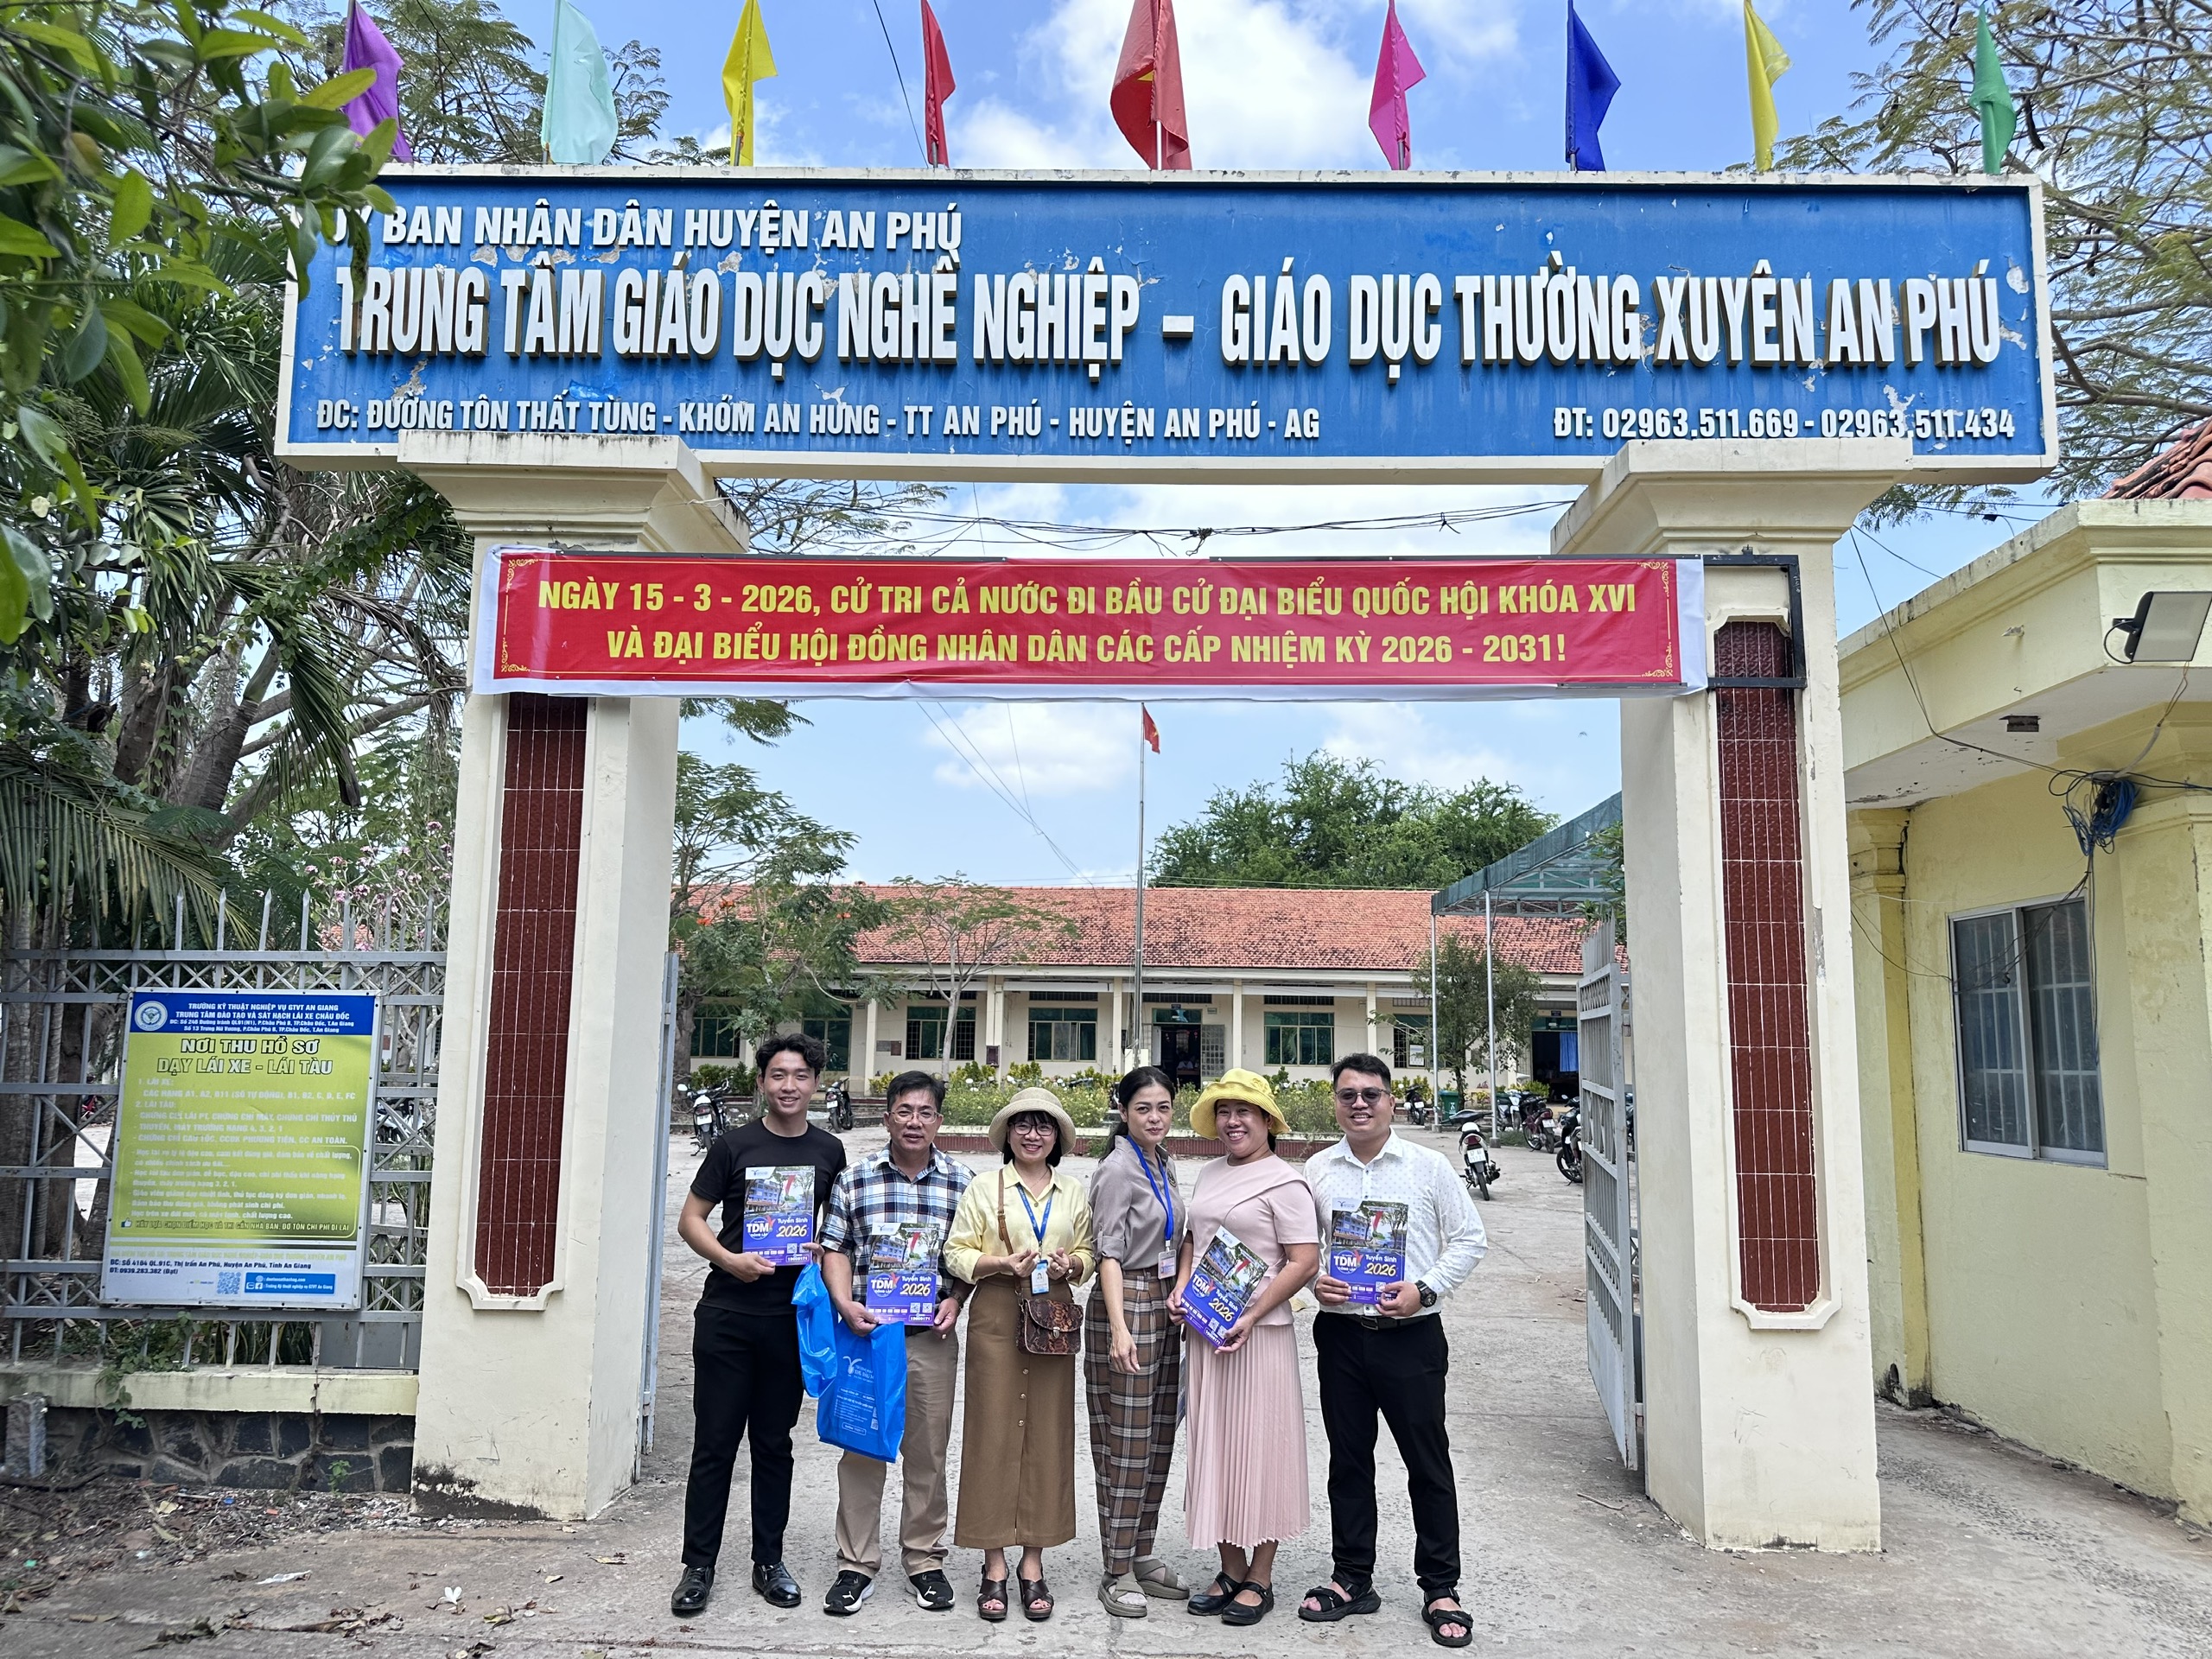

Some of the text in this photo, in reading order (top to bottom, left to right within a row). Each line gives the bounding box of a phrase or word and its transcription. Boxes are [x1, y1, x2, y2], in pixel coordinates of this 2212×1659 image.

[383, 206, 462, 245] BAN
[474, 198, 580, 246] NHÂN
[601, 199, 672, 247] DÂN
[685, 200, 809, 256] HUYỆN
[821, 210, 875, 249] AN
[887, 203, 962, 251] PHÚ
[336, 266, 486, 353] TRUNG
[501, 251, 602, 354] TÂM
[613, 251, 722, 356] GIÁO
[734, 269, 824, 380] DỤC
[838, 249, 962, 361] NGHỀ
[973, 257, 1141, 382] NGHIỆP
[1222, 257, 1332, 365] GIÁO
[1349, 272, 1442, 383] DỤC
[1454, 251, 1640, 365] THƯỜNG
[1656, 259, 1813, 365] XUYÊN
[1827, 278, 1894, 365] AN
[1904, 258, 2001, 365] PHÚ
[316, 399, 359, 429] ĐC:
[366, 391, 453, 430] ĐƯỜNG
[460, 394, 508, 429] TÔN
[517, 389, 580, 431] THẤT
[588, 393, 657, 433] TÙNG
[679, 394, 755, 433] KHÓM
[764, 403, 801, 434] AN
[810, 401, 880, 435] HƯNG
[905, 405, 933, 435] TT
[943, 405, 980, 436] AN
[991, 399, 1041, 437] PHÚ
[1069, 401, 1154, 445] HUYỆN
[1164, 408, 1200, 439] AN
[1209, 401, 1261, 439] PHÚ
[1284, 408, 1320, 439] AG
[1554, 407, 1593, 438] ĐT:
[1602, 408, 1798, 438] 02963.511.669
[1821, 408, 2016, 439] 02963.511.434
[538, 576, 619, 609] NGÀY
[630, 584, 663, 610] 15
[694, 584, 710, 611] 3
[741, 585, 820, 615] 2026,
[831, 577, 872, 613] CỬ
[880, 587, 921, 613] TRI
[932, 577, 969, 613] CẢ
[980, 581, 1057, 613] NƯỚC
[1067, 587, 1095, 613] ĐI
[1106, 577, 1162, 614] BẦU
[1173, 578, 1213, 614] CỬ
[1219, 588, 1267, 620] ĐẠI
[1277, 576, 1342, 615] BIỂU
[1357, 577, 1429, 618] QUỐC
[1440, 581, 1488, 620] HỘI
[1499, 580, 1579, 613] KHÓA
[1588, 584, 1635, 612] XVI
[607, 626, 644, 658] VÀ
[653, 632, 702, 664] ĐẠI
[714, 622, 779, 660] BIỂU
[791, 628, 837, 666] HỘI
[848, 625, 926, 662] ĐỒNG
[937, 629, 1017, 661] NHÂN
[1028, 630, 1086, 661] DÂN
[1097, 630, 1154, 662] CÁC
[1164, 626, 1221, 662] CẤP
[1231, 630, 1325, 669] NHIỆM
[1336, 631, 1371, 663] KỲ
[1382, 636, 1452, 663] 2026
[1484, 634, 1565, 662] 2031!
[335, 1011, 350, 1020] ĐỐC
[181, 1036, 321, 1054] NƠI THU HỒ SƠ
[157, 1058, 193, 1076] DẠY
[196, 1056, 225, 1073] LÁI
[227, 1059, 251, 1073] XE
[267, 1057, 295, 1074] LÁI
[300, 1057, 334, 1075] TÀU
[747, 1223, 770, 1233] TDM
[776, 1225, 807, 1237] 2026
[1333, 1255, 1357, 1268] TDM
[1365, 1253, 1382, 1262] Tuyển
[1364, 1262, 1396, 1277] 2026
[871, 1280, 893, 1289] TDM
[899, 1283, 931, 1296] 2026
[1192, 1274, 1210, 1294] TDM
[1209, 1298, 1235, 1322] 2026
